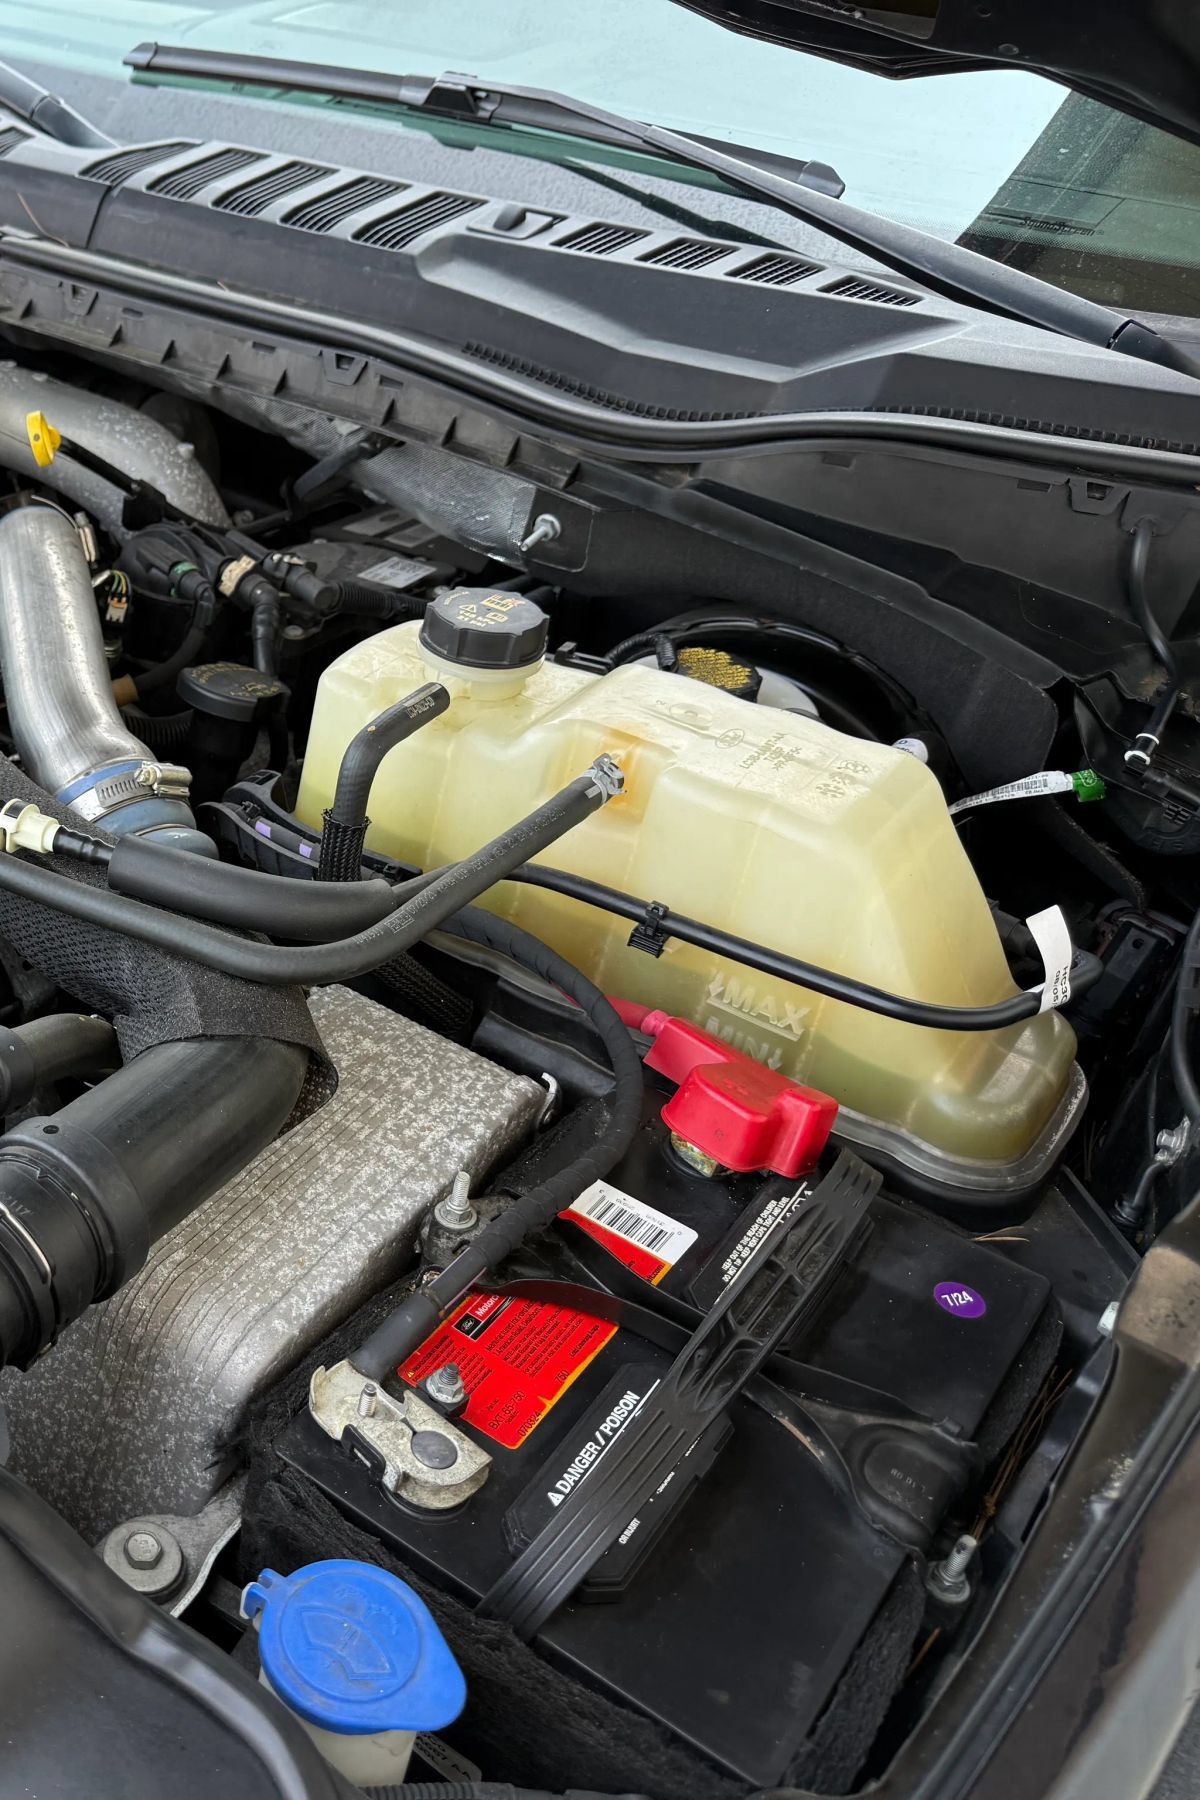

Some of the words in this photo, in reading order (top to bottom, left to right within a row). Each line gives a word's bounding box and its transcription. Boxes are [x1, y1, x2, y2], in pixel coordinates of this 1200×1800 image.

[723, 976, 811, 1035] MAX
[705, 1015, 770, 1062] MIN
[722, 1259, 732, 1270] KEEP
[730, 1250, 740, 1260] OUT
[740, 1236, 751, 1245] THE
[746, 1223, 760, 1237] REACH
[760, 1200, 777, 1218] CHILDREN
[727, 1265, 738, 1276] NOT
[734, 1258, 742, 1266] TIP
[740, 1247, 751, 1258] KEEP
[748, 1236, 759, 1247] VENT
[756, 1226, 767, 1237] CAPS
[772, 1207, 781, 1216] AND
[941, 1291, 973, 1307] 7/24
[552, 1367, 571, 1385] 750
[515, 1408, 544, 1438] 070324
[555, 1441, 602, 1494] DANGER
[599, 1390, 640, 1436] POISON
